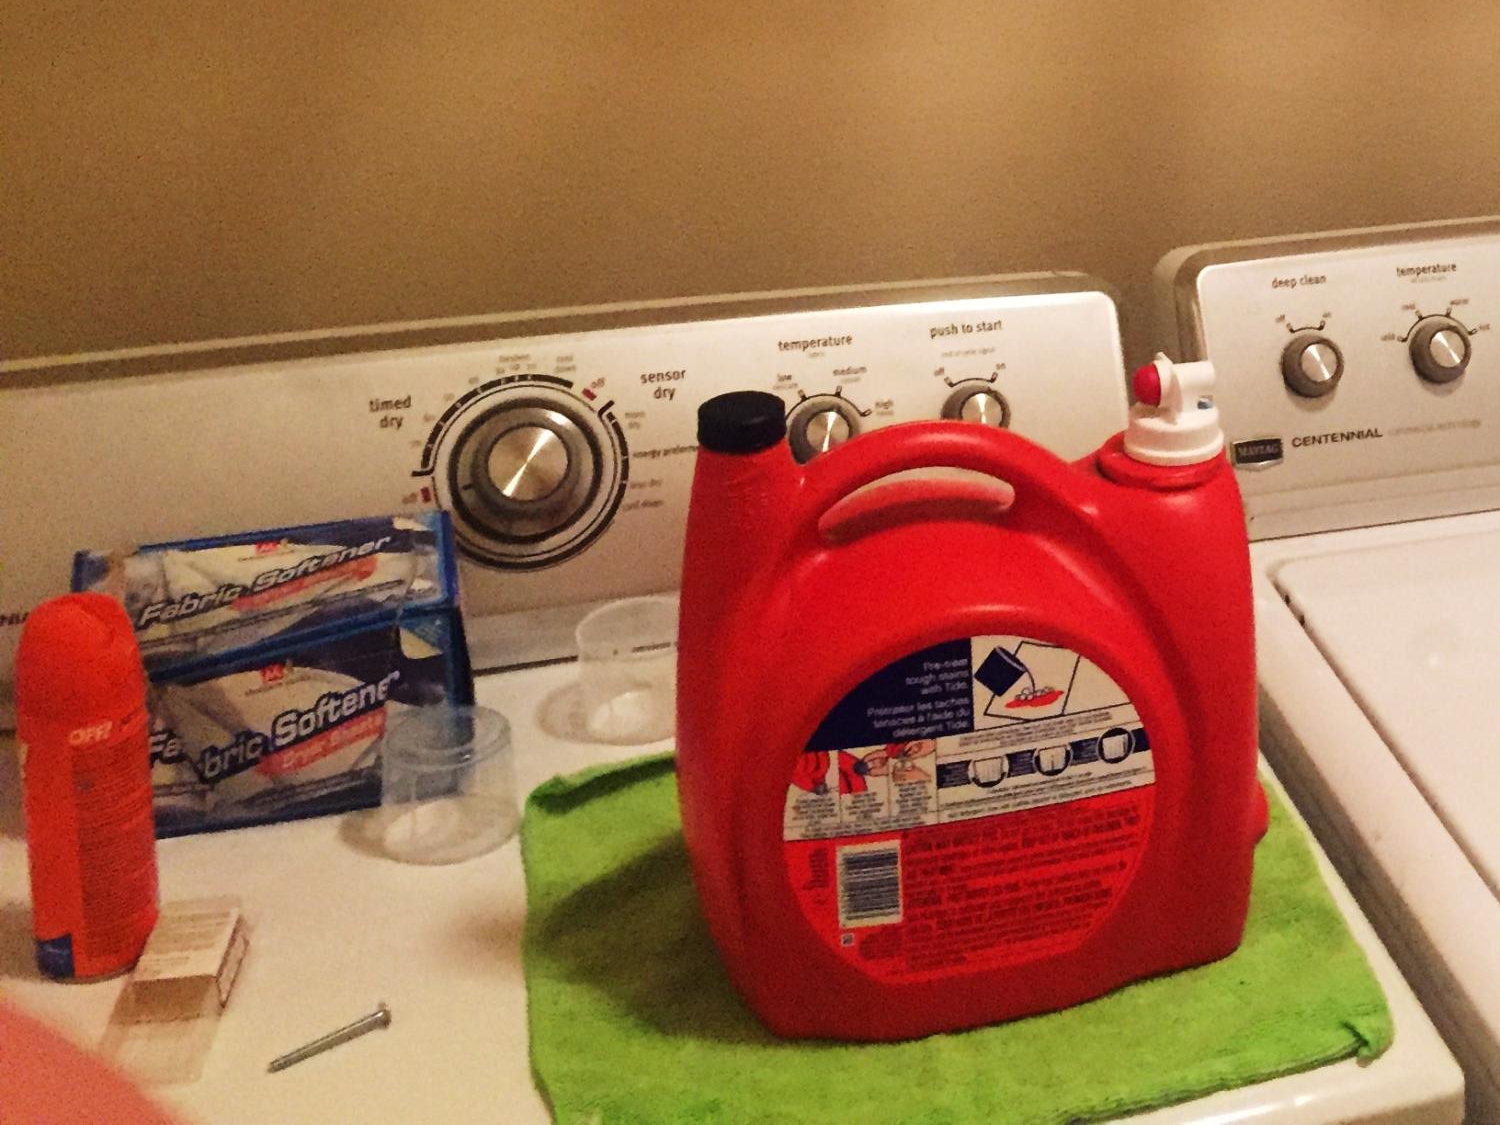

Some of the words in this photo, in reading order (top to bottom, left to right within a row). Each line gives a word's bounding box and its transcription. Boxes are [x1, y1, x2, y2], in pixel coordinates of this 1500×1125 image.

[1396, 263, 1457, 277] temperature
[1271, 277, 1297, 289] deep
[1299, 275, 1327, 286] clean
[929, 323, 959, 339] push
[961, 322, 973, 334] to
[976, 320, 1002, 333] start
[777, 334, 854, 352] temperature
[640, 369, 687, 384] sensor
[832, 366, 868, 377] medium
[653, 386, 677, 401] dry
[368, 394, 412, 413] timed
[379, 415, 405, 431] dry
[1291, 428, 1384, 448] CENTENNIAL
[1237, 443, 1279, 457] MAYTAG
[138, 586, 242, 625] Fabric
[252, 536, 391, 592] Softener
[905, 673, 936, 686] tough
[938, 670, 970, 681] stains
[920, 683, 943, 695] with
[916, 701, 932, 711] les
[934, 696, 970, 709] taches
[956, 708, 970, 717] du
[69, 721, 113, 747] OFF!
